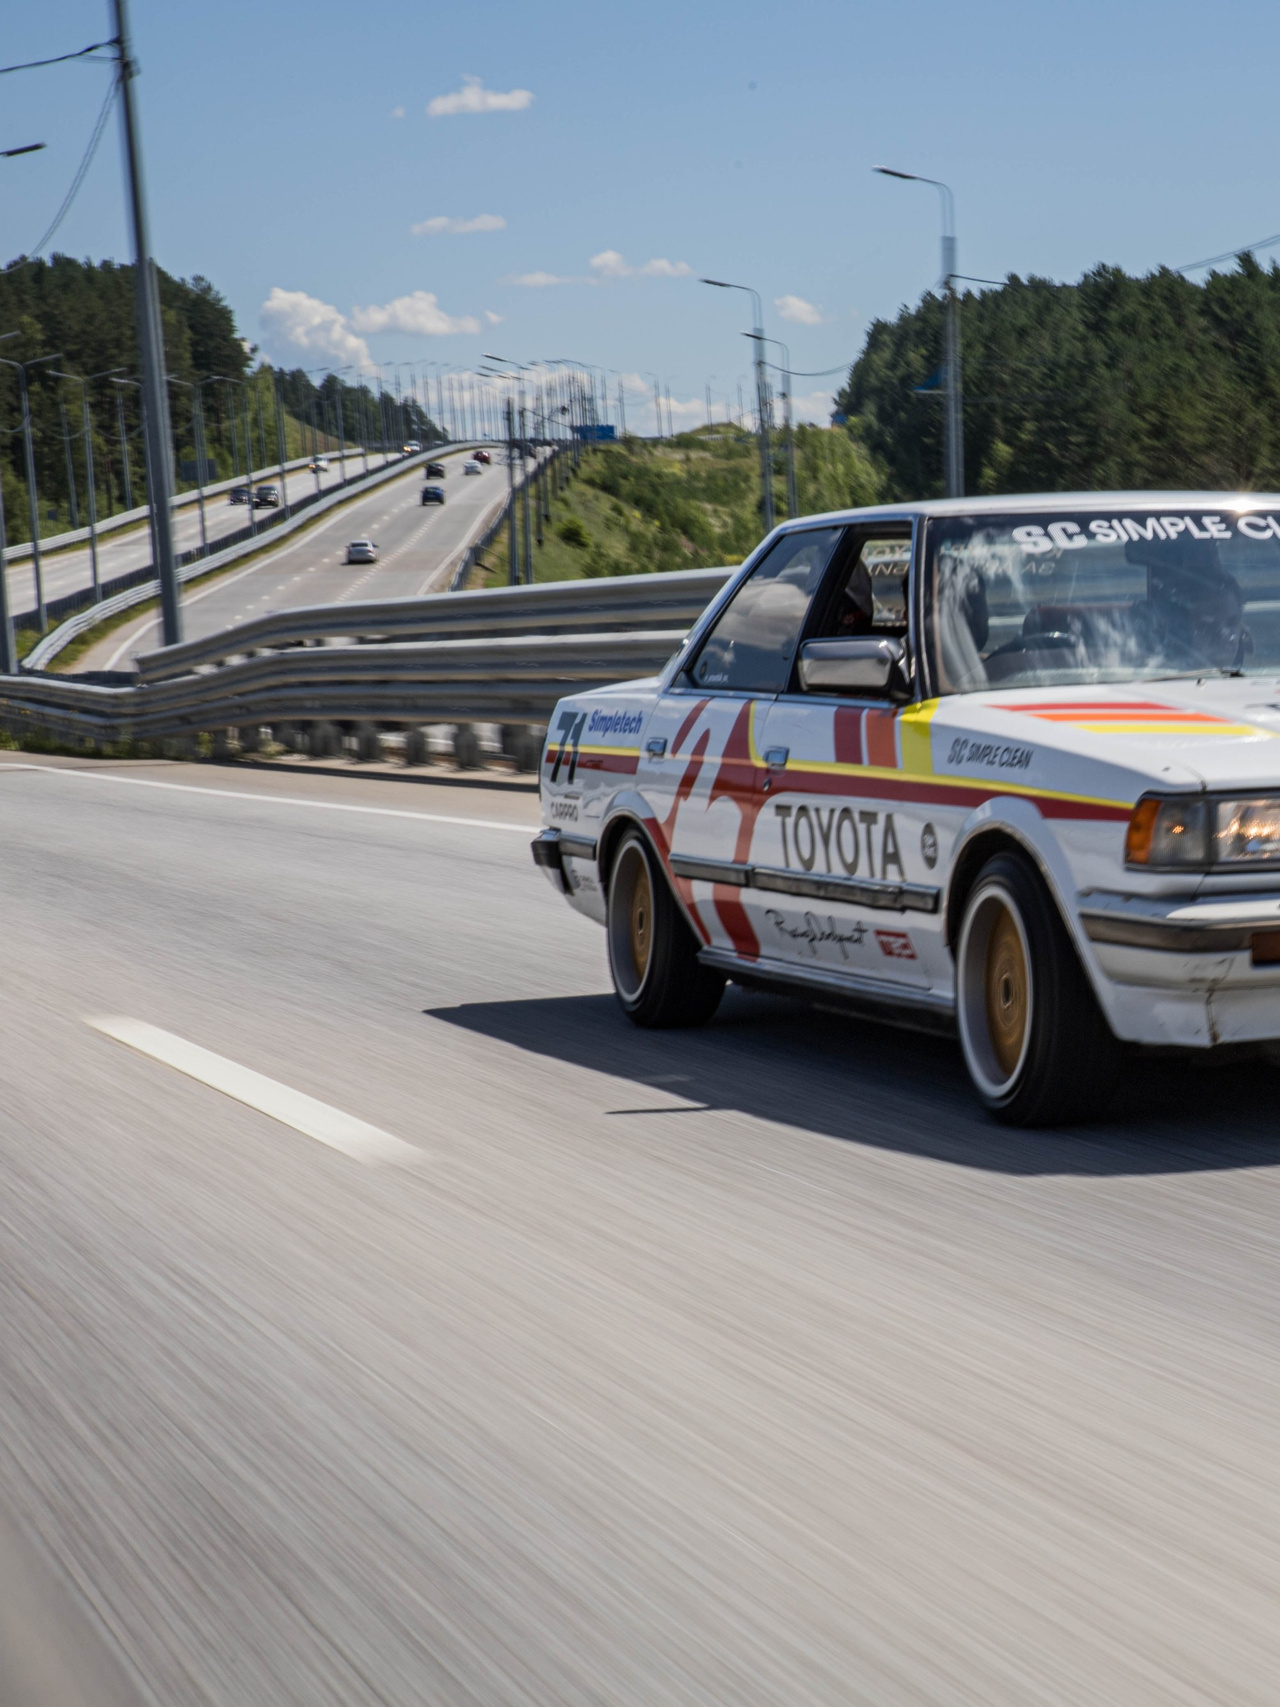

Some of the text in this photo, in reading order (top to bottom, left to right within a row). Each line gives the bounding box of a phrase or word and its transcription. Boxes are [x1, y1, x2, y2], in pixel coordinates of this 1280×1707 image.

[1012, 521, 1088, 555] SC
[1088, 515, 1232, 544] SIMPLE
[588, 708, 643, 738] Simpletech
[550, 711, 588, 785] 71
[966, 741, 1002, 767] SIMPLE
[998, 745, 1034, 770] CLEAN
[774, 804, 907, 883] TOYOTA
